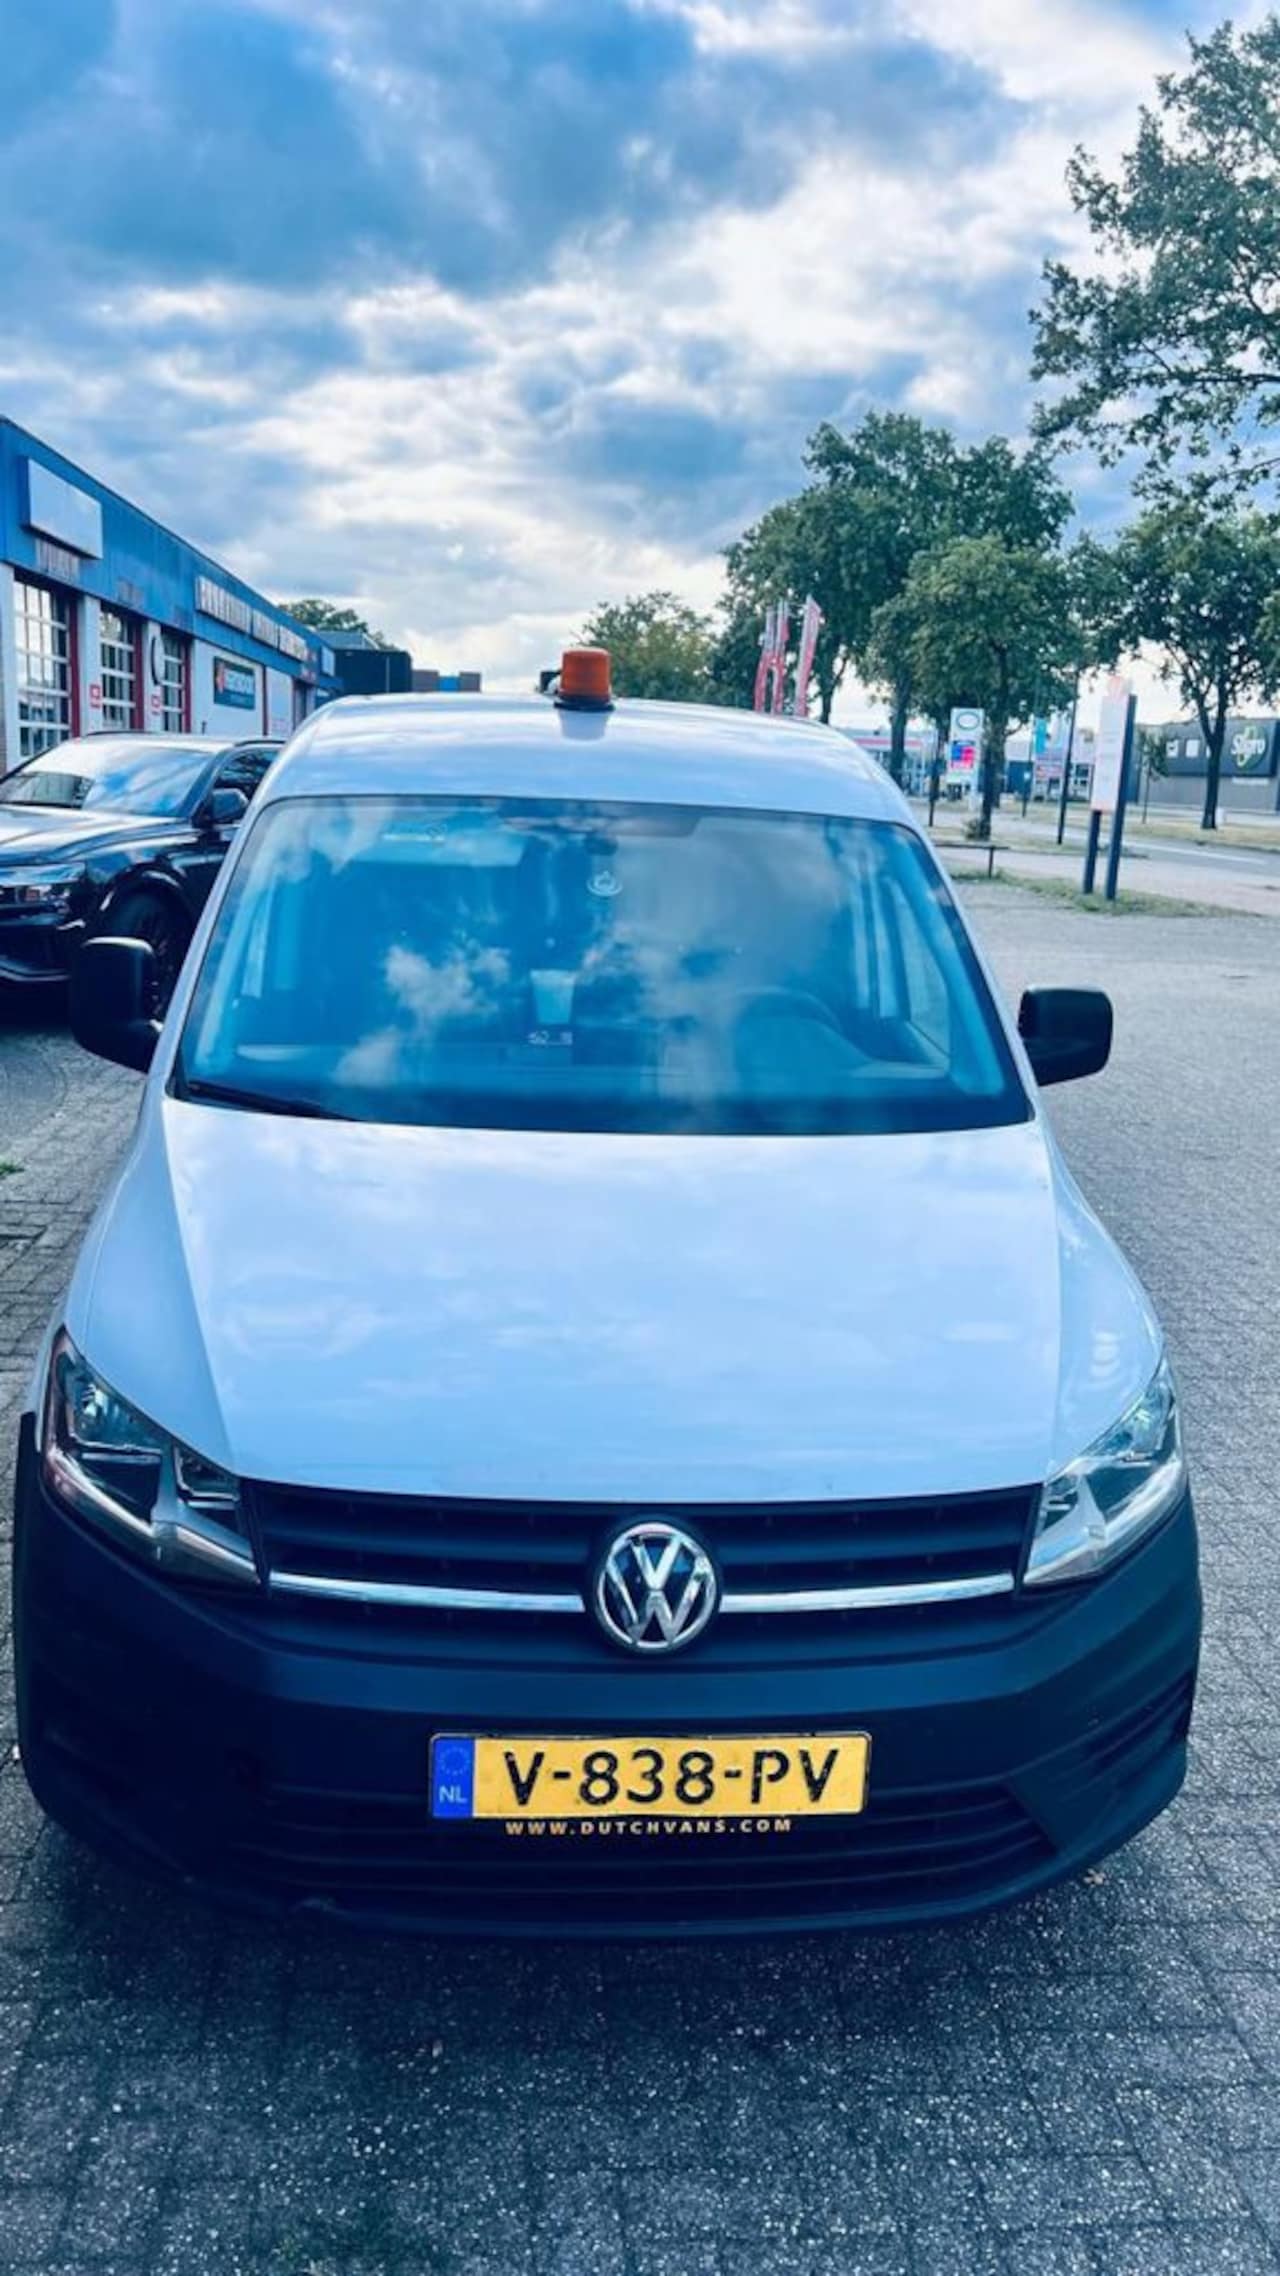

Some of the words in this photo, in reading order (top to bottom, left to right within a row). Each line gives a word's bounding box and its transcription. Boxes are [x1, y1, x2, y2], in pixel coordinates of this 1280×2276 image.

[504, 1749, 838, 1806] V-838-PV
[438, 1785, 468, 1804] NL
[505, 1819, 792, 1836] WWW.DUTCHVANS.COM
